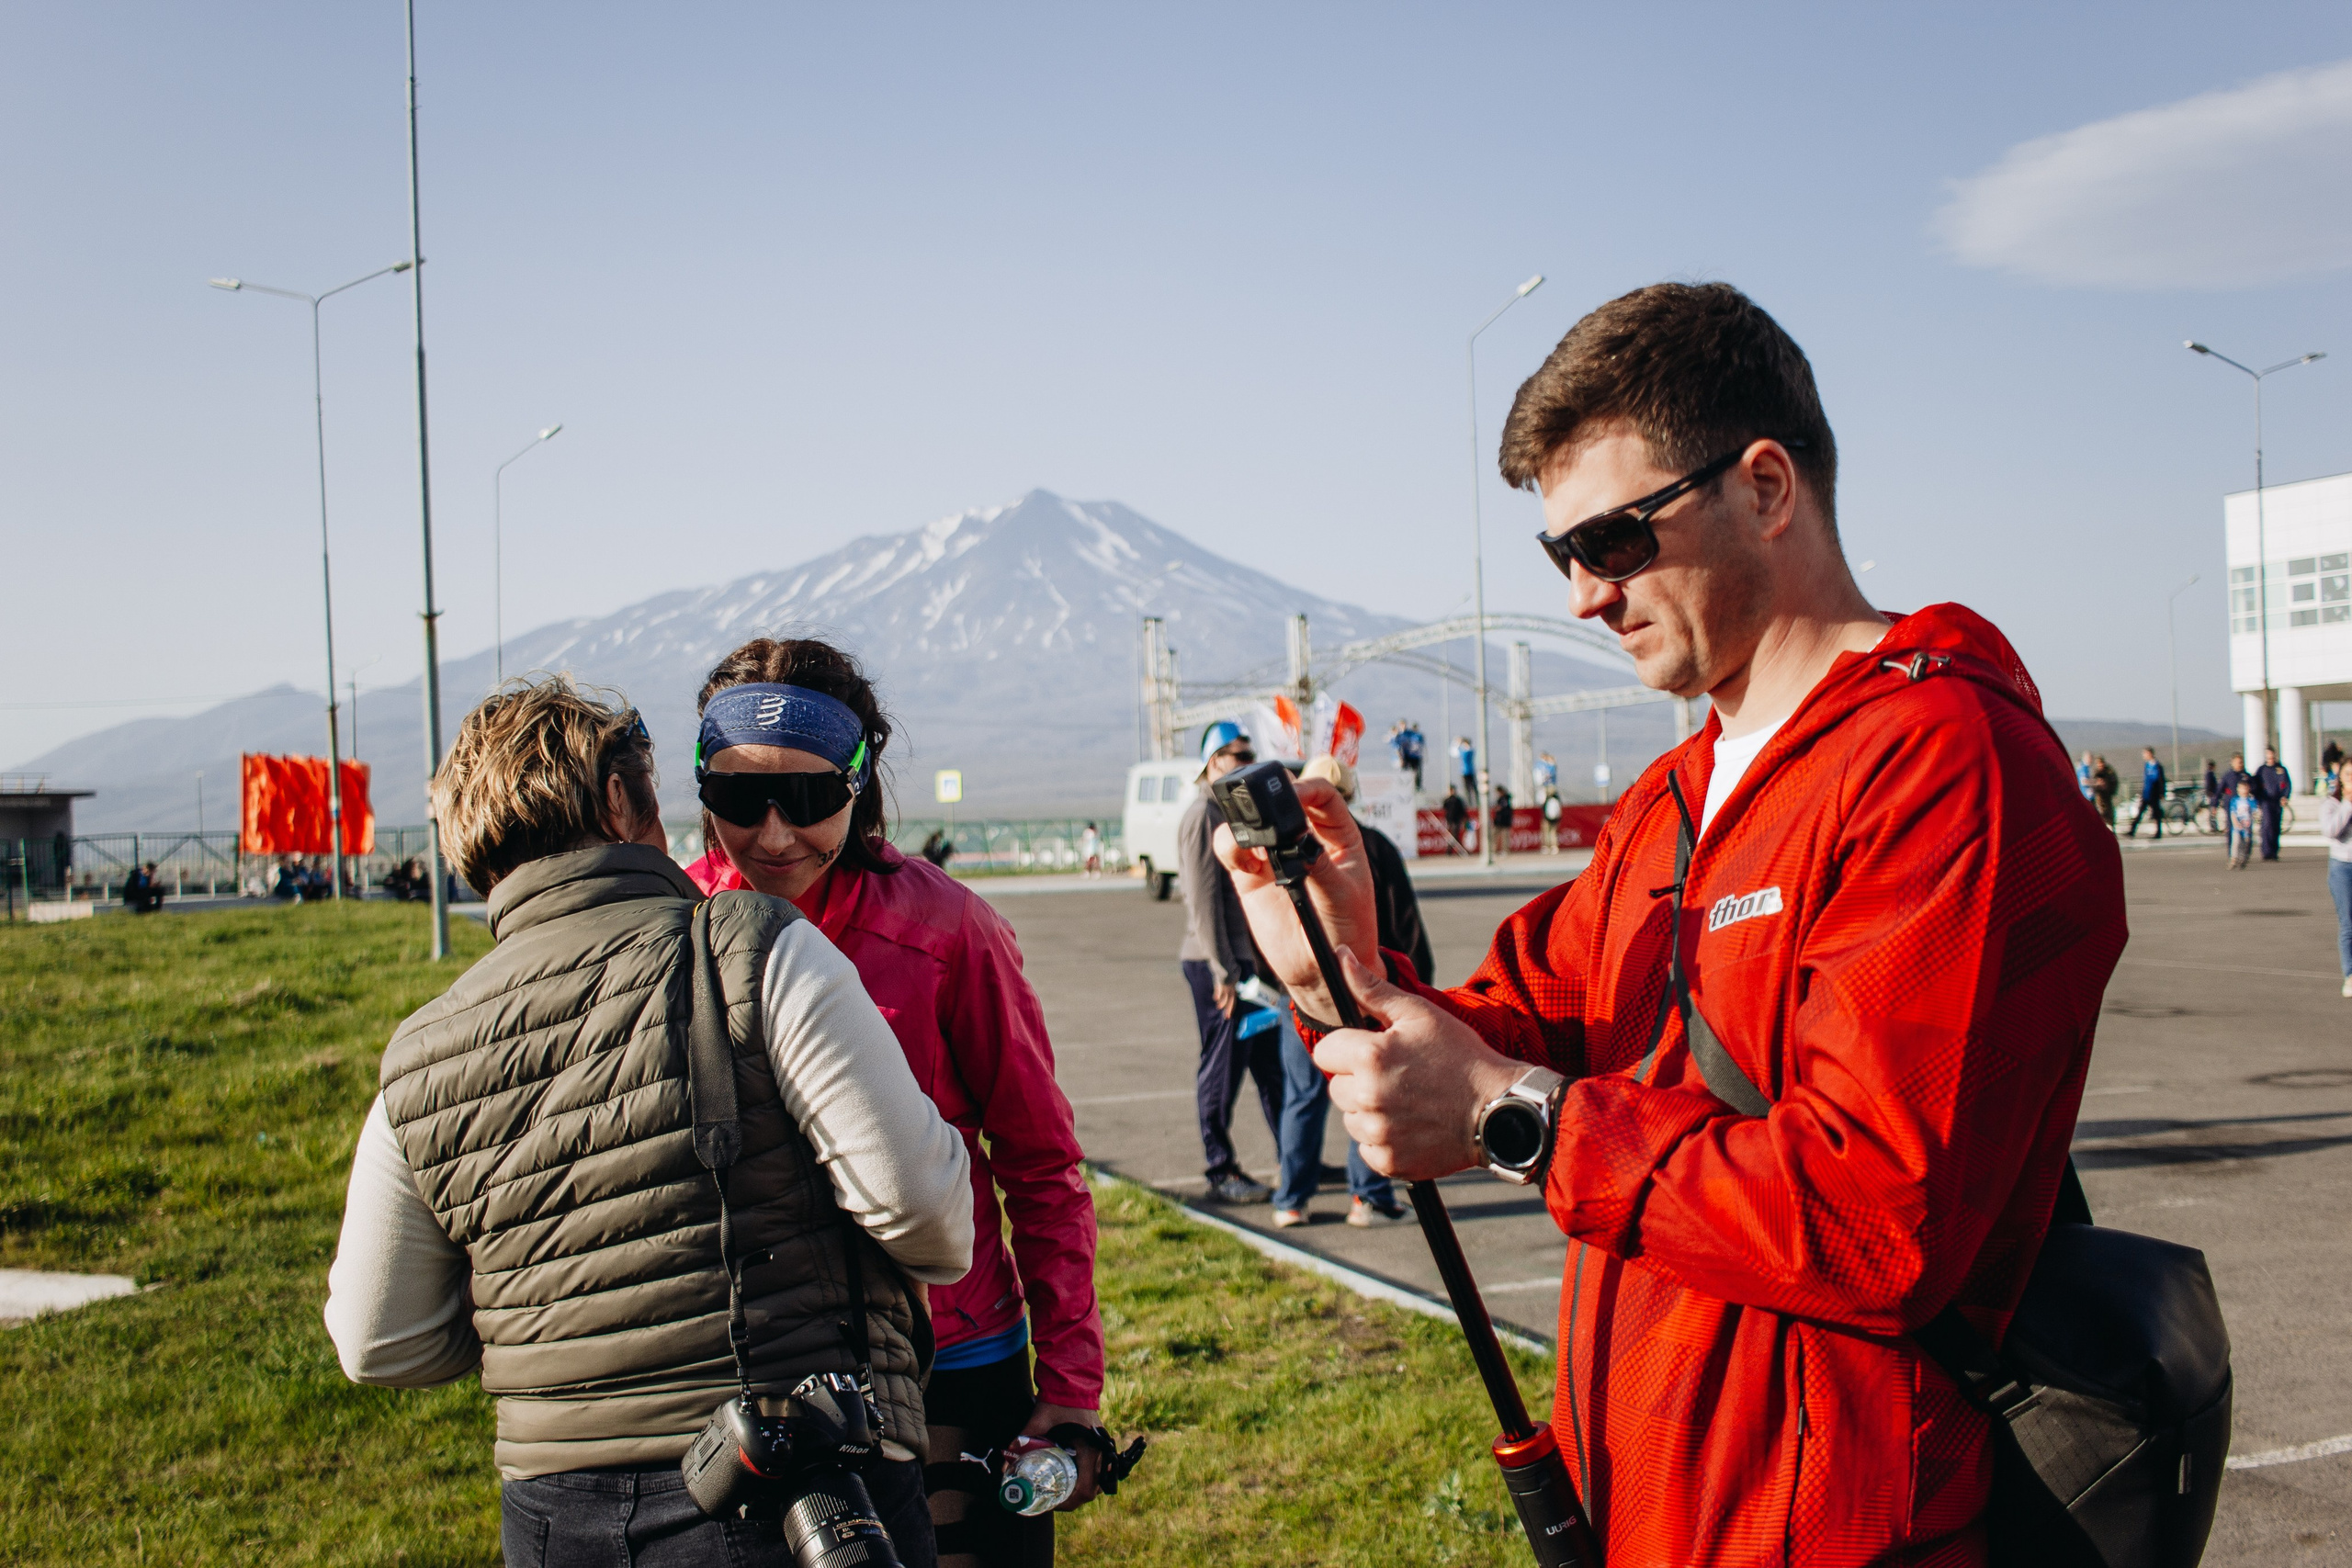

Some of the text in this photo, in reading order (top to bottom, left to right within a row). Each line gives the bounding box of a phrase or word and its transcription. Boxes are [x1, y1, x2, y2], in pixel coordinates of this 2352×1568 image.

[1710, 890, 1779, 929] thor
[839, 1444, 870, 1454] Nikon
[1545, 1515, 1577, 1536] UURIG
